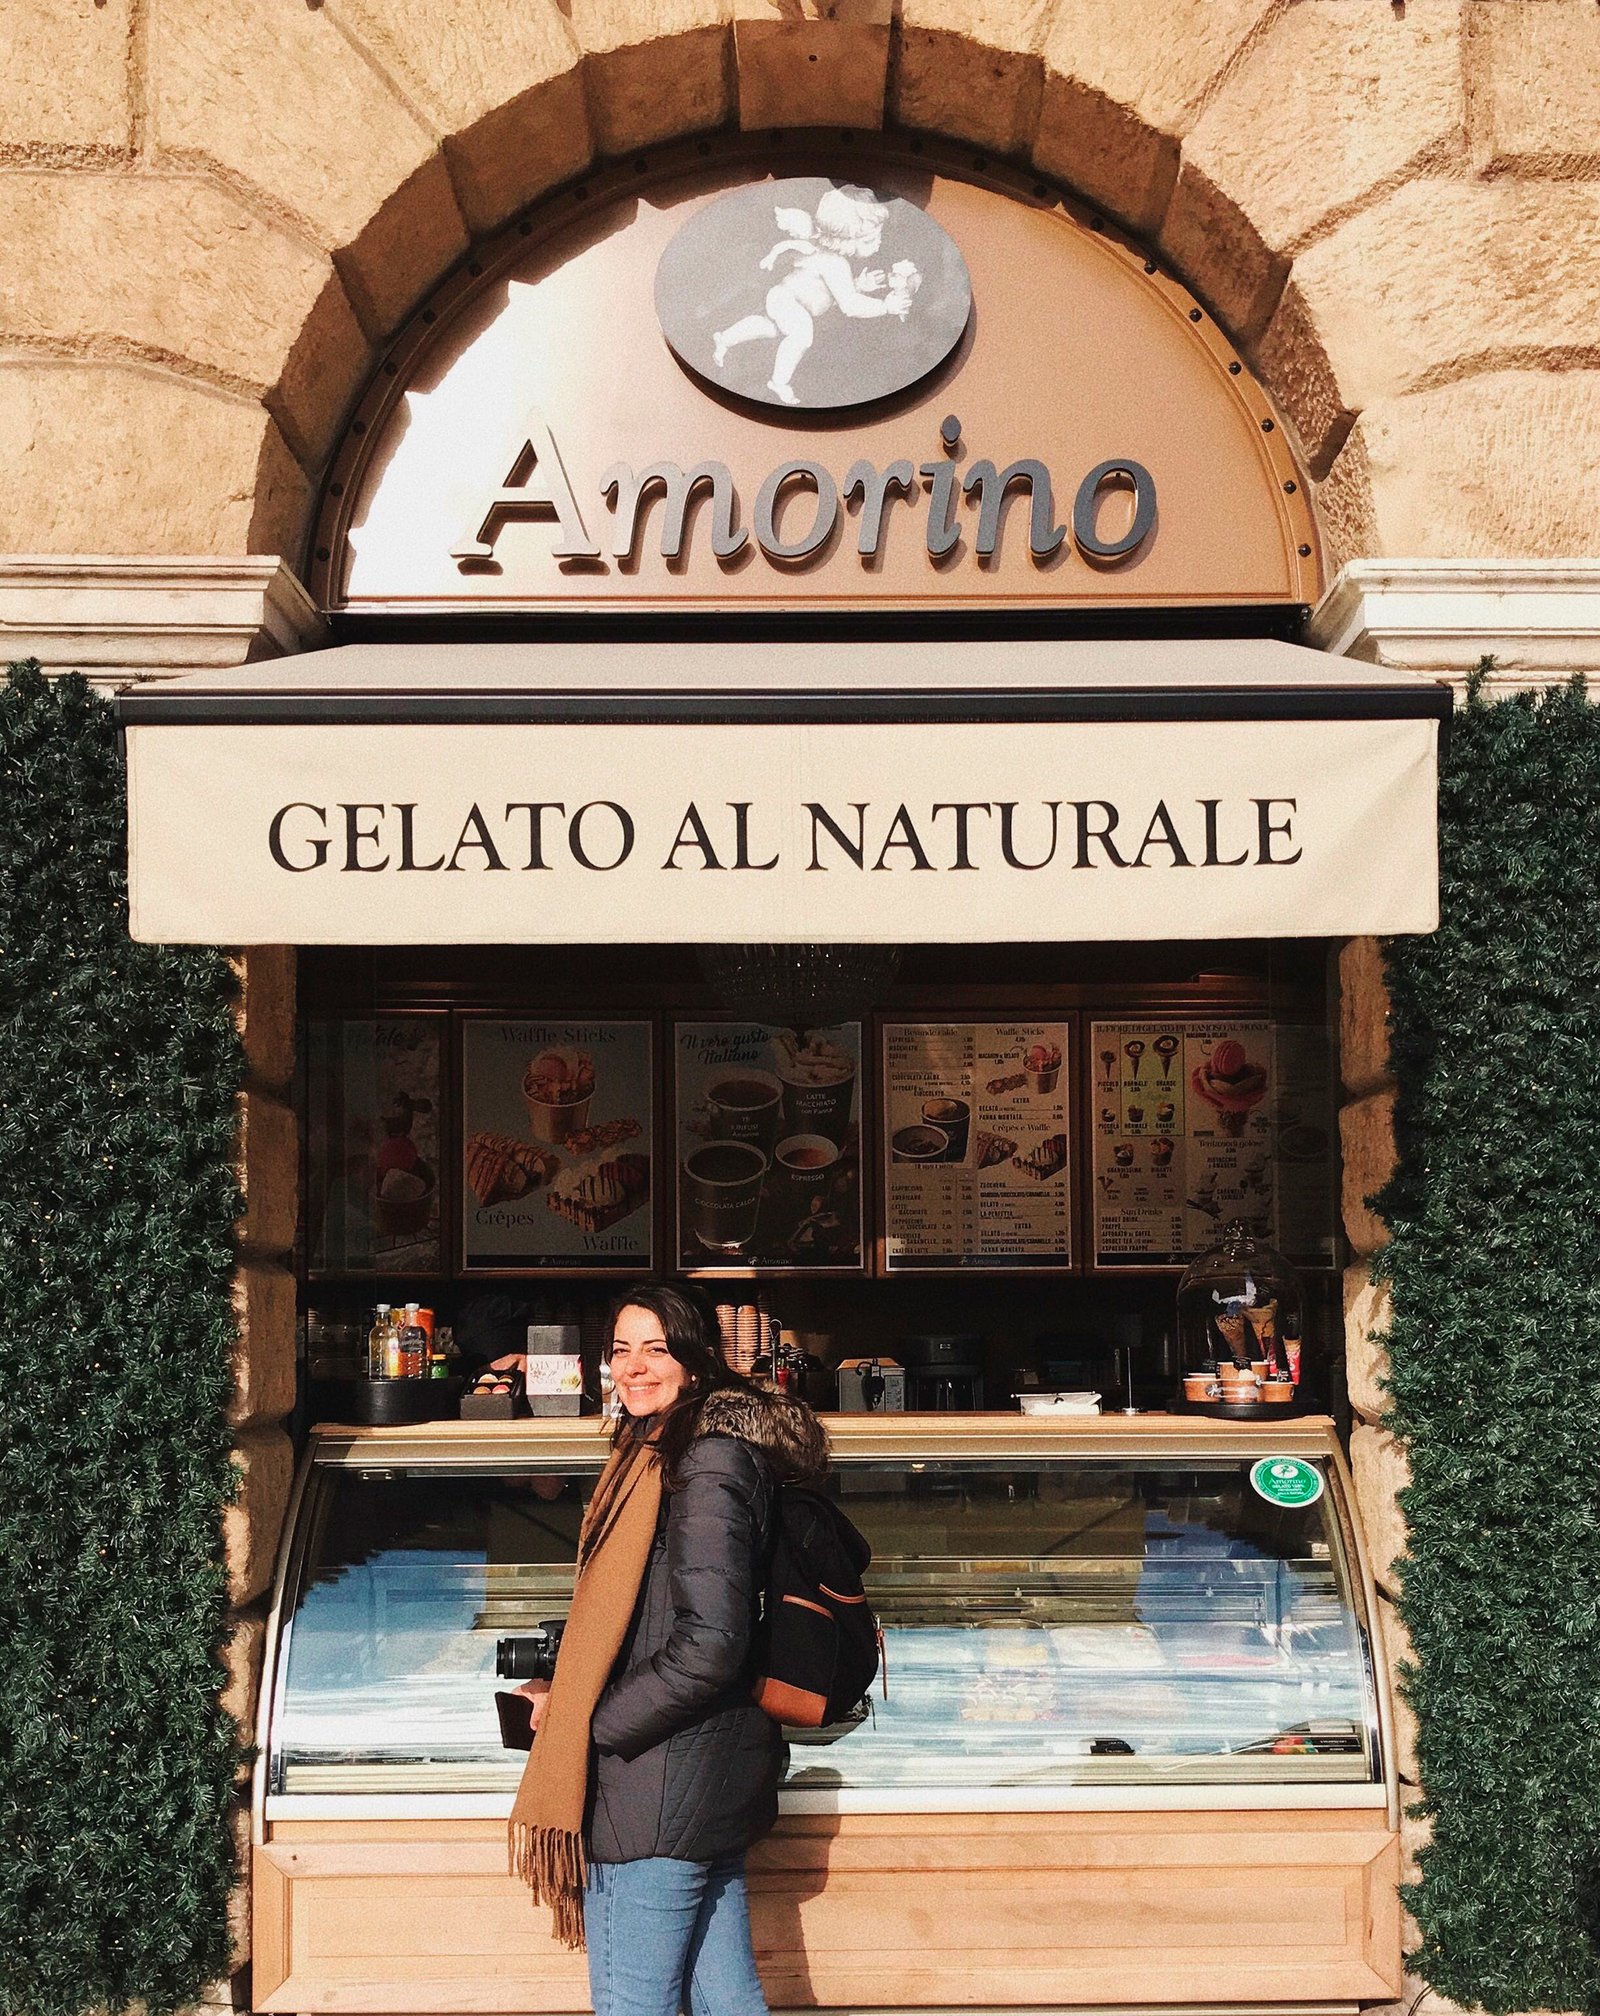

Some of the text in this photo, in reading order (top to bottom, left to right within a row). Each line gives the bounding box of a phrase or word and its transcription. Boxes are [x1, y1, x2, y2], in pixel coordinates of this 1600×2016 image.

[449, 415, 1158, 558] Amorino
[268, 798, 1303, 873] GELATO AL NATURALE
[500, 1027, 616, 1043] Waffle Sticks
[701, 1036, 729, 1047] vero
[729, 1029, 771, 1051] gusto
[698, 1048, 760, 1065] Italiano
[475, 1210, 534, 1228] Crêpes
[583, 1235, 639, 1251] Waffle
